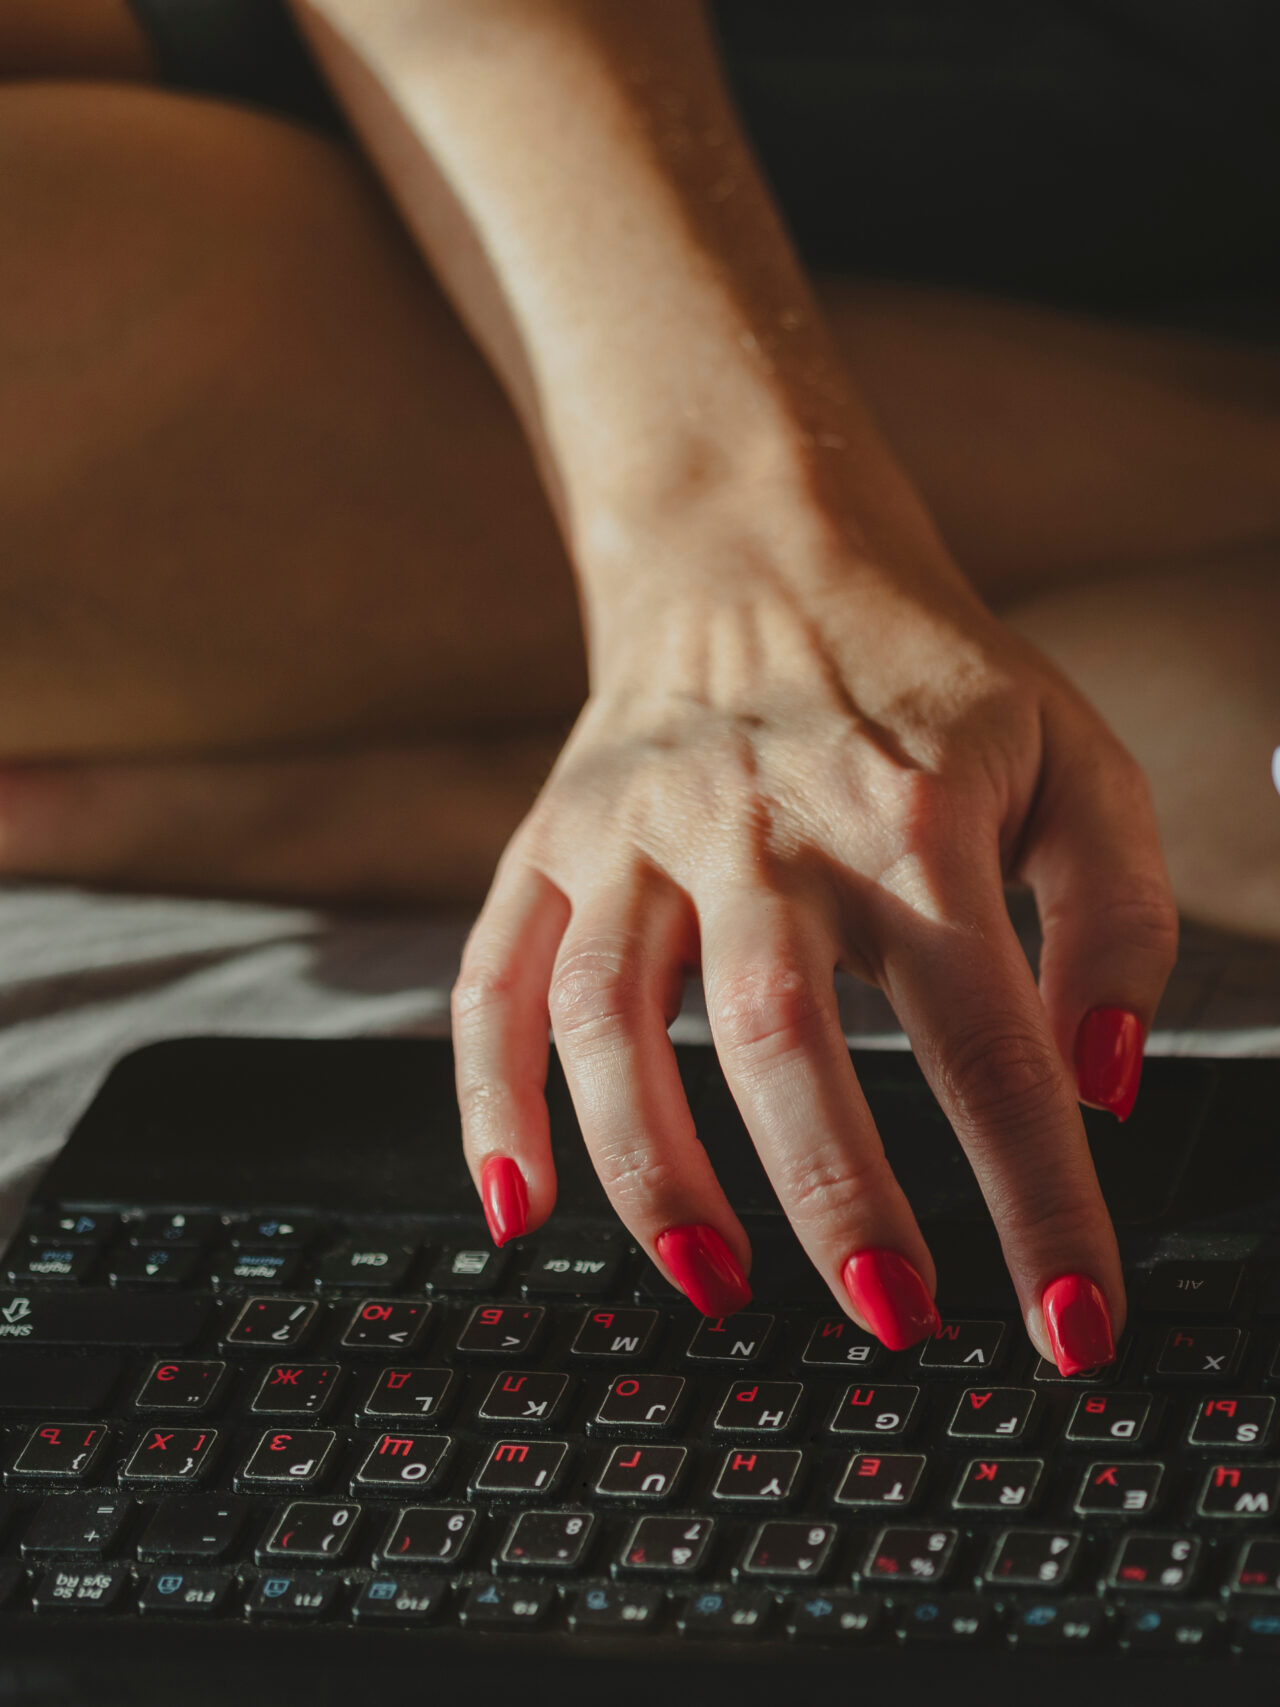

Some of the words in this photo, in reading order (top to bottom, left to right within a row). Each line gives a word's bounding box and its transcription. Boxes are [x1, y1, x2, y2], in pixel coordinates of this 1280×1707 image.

[352, 1254, 388, 1265] Ctrl
[544, 1261, 569, 1272] Gr
[574, 1261, 604, 1273] Alt
[1178, 1280, 1203, 1290] Alt
[362, 1306, 392, 1320] Ю
[480, 1310, 503, 1324] Б
[272, 1326, 289, 1340] ?
[822, 1324, 843, 1337] И
[611, 1337, 639, 1351] M
[1174, 1333, 1193, 1347] Ч
[731, 1342, 754, 1355] N
[847, 1347, 870, 1360] B
[964, 1349, 984, 1362] V
[1203, 1356, 1224, 1369] X
[157, 1366, 178, 1380] Э
[272, 1370, 302, 1384] Ж
[387, 1372, 411, 1388] Д
[502, 1377, 526, 1392] Л
[416, 1397, 432, 1411] L
[851, 1390, 874, 1405] П
[646, 1405, 666, 1419] J
[1206, 1401, 1236, 1417] Ы
[758, 1411, 783, 1426] H
[875, 1414, 899, 1429] G
[996, 1418, 1017, 1433] F
[1111, 1421, 1135, 1436] D
[1237, 1424, 1258, 1441] S
[40, 1429, 60, 1444] Ъ
[380, 1436, 413, 1456] Щ
[496, 1445, 528, 1462] Ш
[179, 1458, 193, 1473] {
[620, 1452, 641, 1467] Г
[642, 1475, 665, 1491] U
[1216, 1467, 1240, 1487] Ц
[760, 1479, 781, 1495] Y
[884, 1483, 903, 1500] T
[1000, 1487, 1025, 1504] R
[1236, 1493, 1268, 1511] W
[448, 1515, 464, 1531] 9
[566, 1519, 582, 1534] 8
[84, 1531, 99, 1541] +
[684, 1524, 700, 1539] 7
[808, 1529, 825, 1545] 6
[929, 1534, 946, 1551] 5
[1051, 1538, 1068, 1554] 4
[1172, 1542, 1189, 1560] 3
[82, 1574, 110, 1588] Sys
[53, 1587, 75, 1599] Sc
[78, 1587, 103, 1600] Prt
[185, 1591, 215, 1602] F12
[295, 1595, 322, 1606] F11
